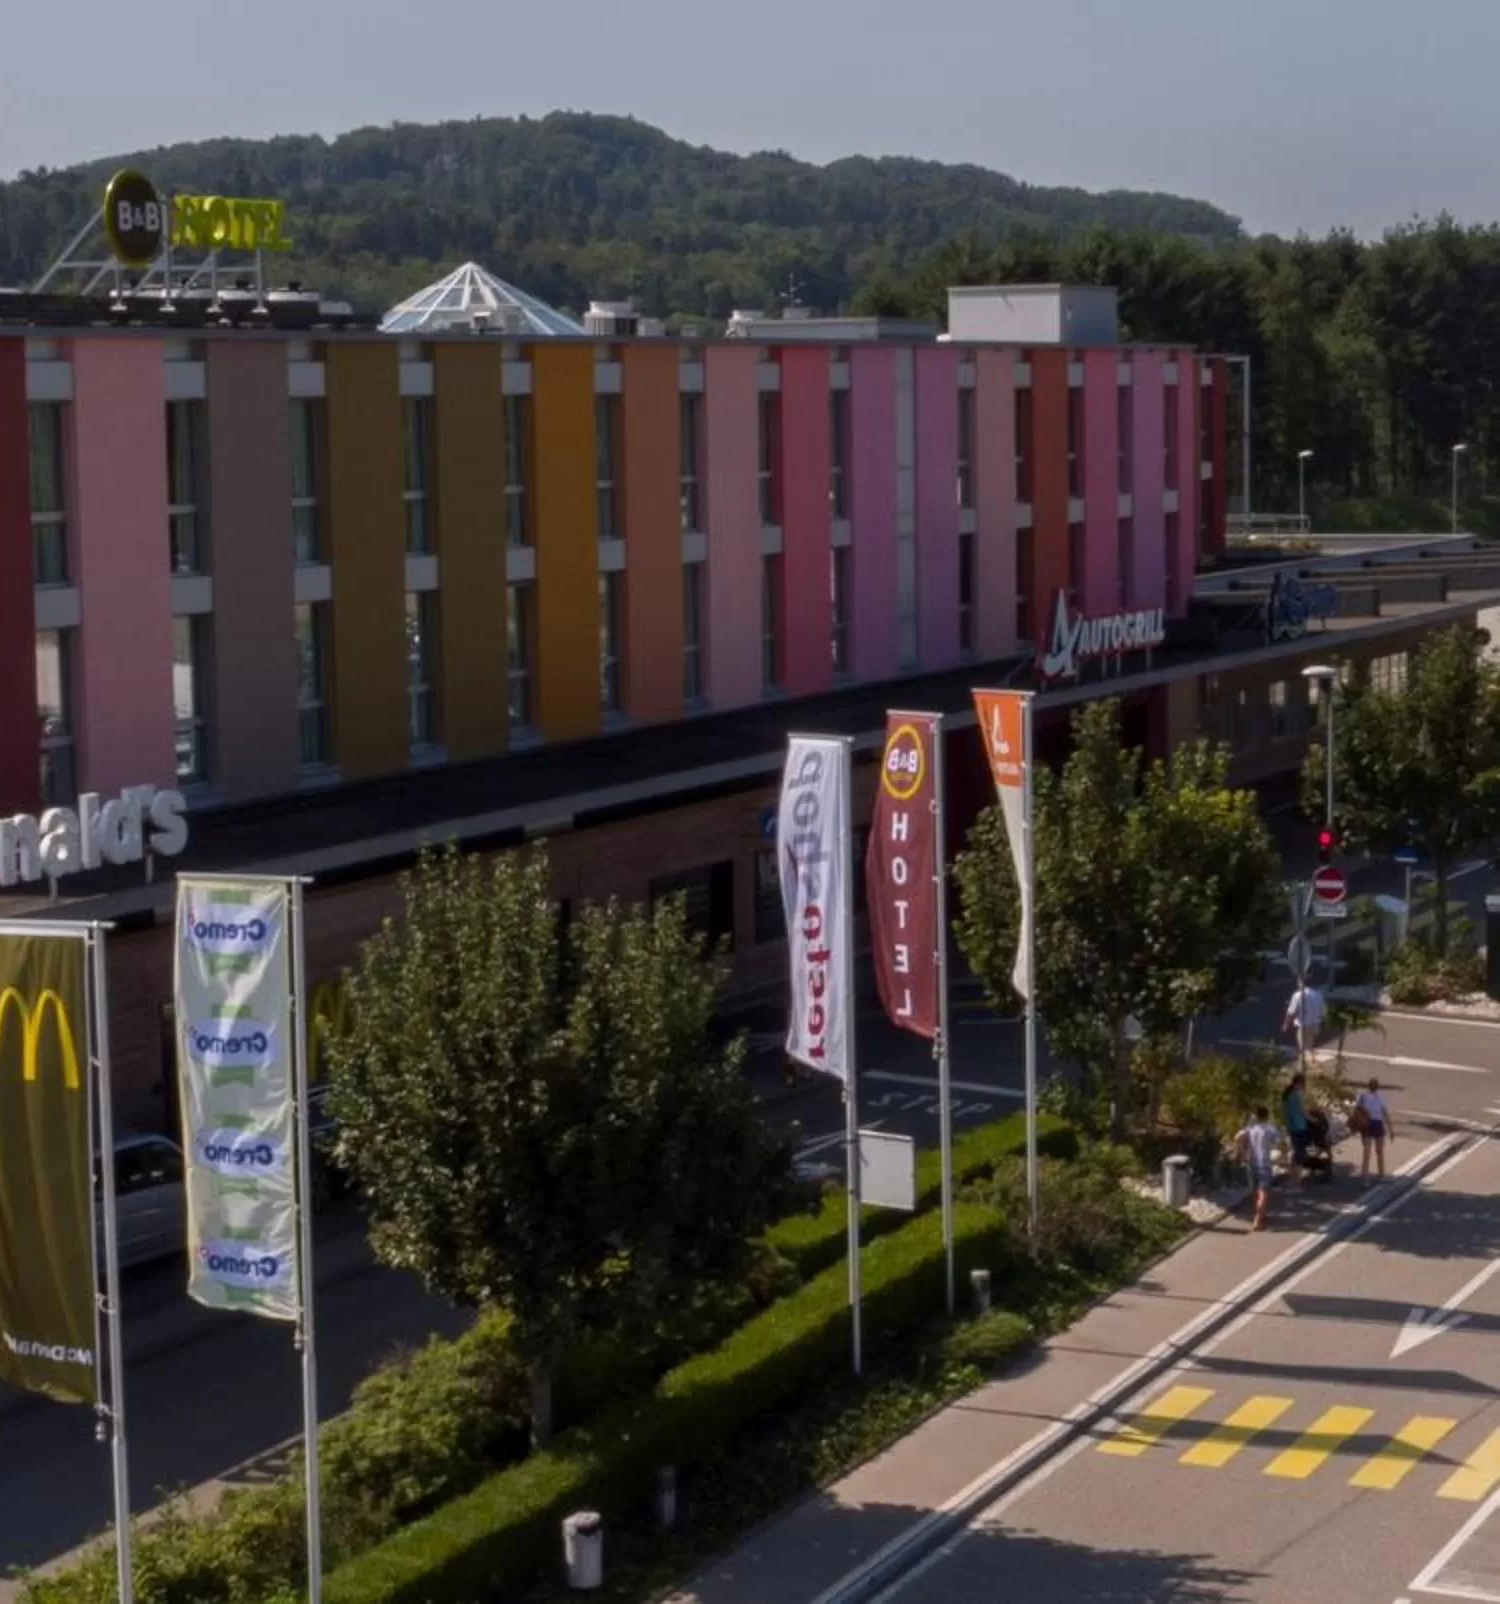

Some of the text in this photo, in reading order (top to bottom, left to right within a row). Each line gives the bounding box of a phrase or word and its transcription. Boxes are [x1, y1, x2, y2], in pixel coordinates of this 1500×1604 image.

[118, 201, 160, 231] B&B
[172, 194, 293, 250] HOTEL
[1077, 608, 1165, 655] AUTOGRILL
